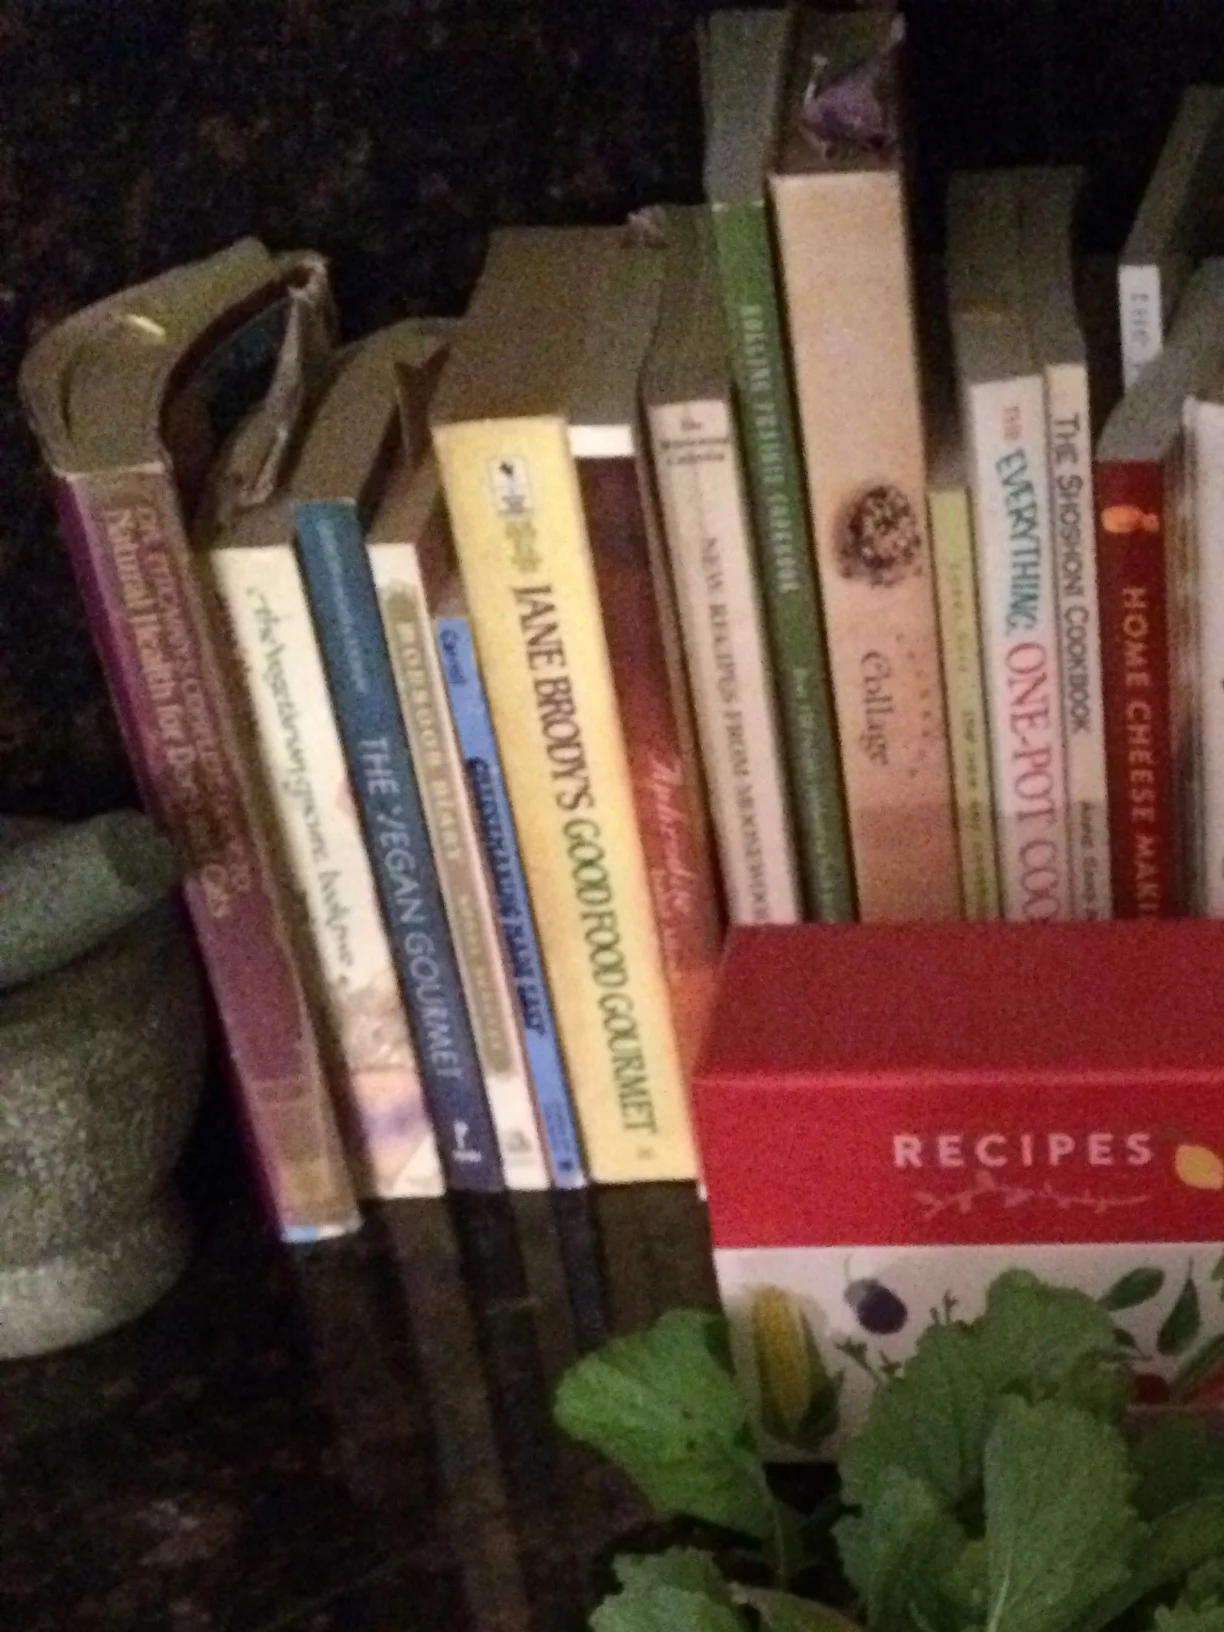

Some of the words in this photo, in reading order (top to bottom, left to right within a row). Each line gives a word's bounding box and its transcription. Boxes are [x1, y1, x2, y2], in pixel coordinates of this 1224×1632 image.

[1052, 412, 1081, 464] THE
[98, 509, 155, 610] Natural
[993, 447, 1042, 630] EVERYTHING
[1055, 473, 1088, 598] SHOSHONI
[127, 613, 180, 704] Health
[510, 583, 568, 671] JANE
[1063, 609, 1094, 734] COOKBOOK
[1122, 587, 1150, 686] HOME
[152, 702, 191, 741] for
[530, 675, 596, 811] BRODY'S
[850, 649, 900, 766] Collage
[1004, 641, 1055, 824] ONE-POT
[357, 736, 400, 796] THE
[1125, 701, 1155, 821] CHEESE
[196, 862, 237, 919] Cats
[372, 804, 429, 924] VEGAN
[561, 817, 614, 907] GOOD
[579, 908, 629, 986] FOOD
[402, 931, 465, 1081] GOURMET
[595, 992, 658, 1133] GOURMET
[892, 1132, 1155, 1169] RECIPES
